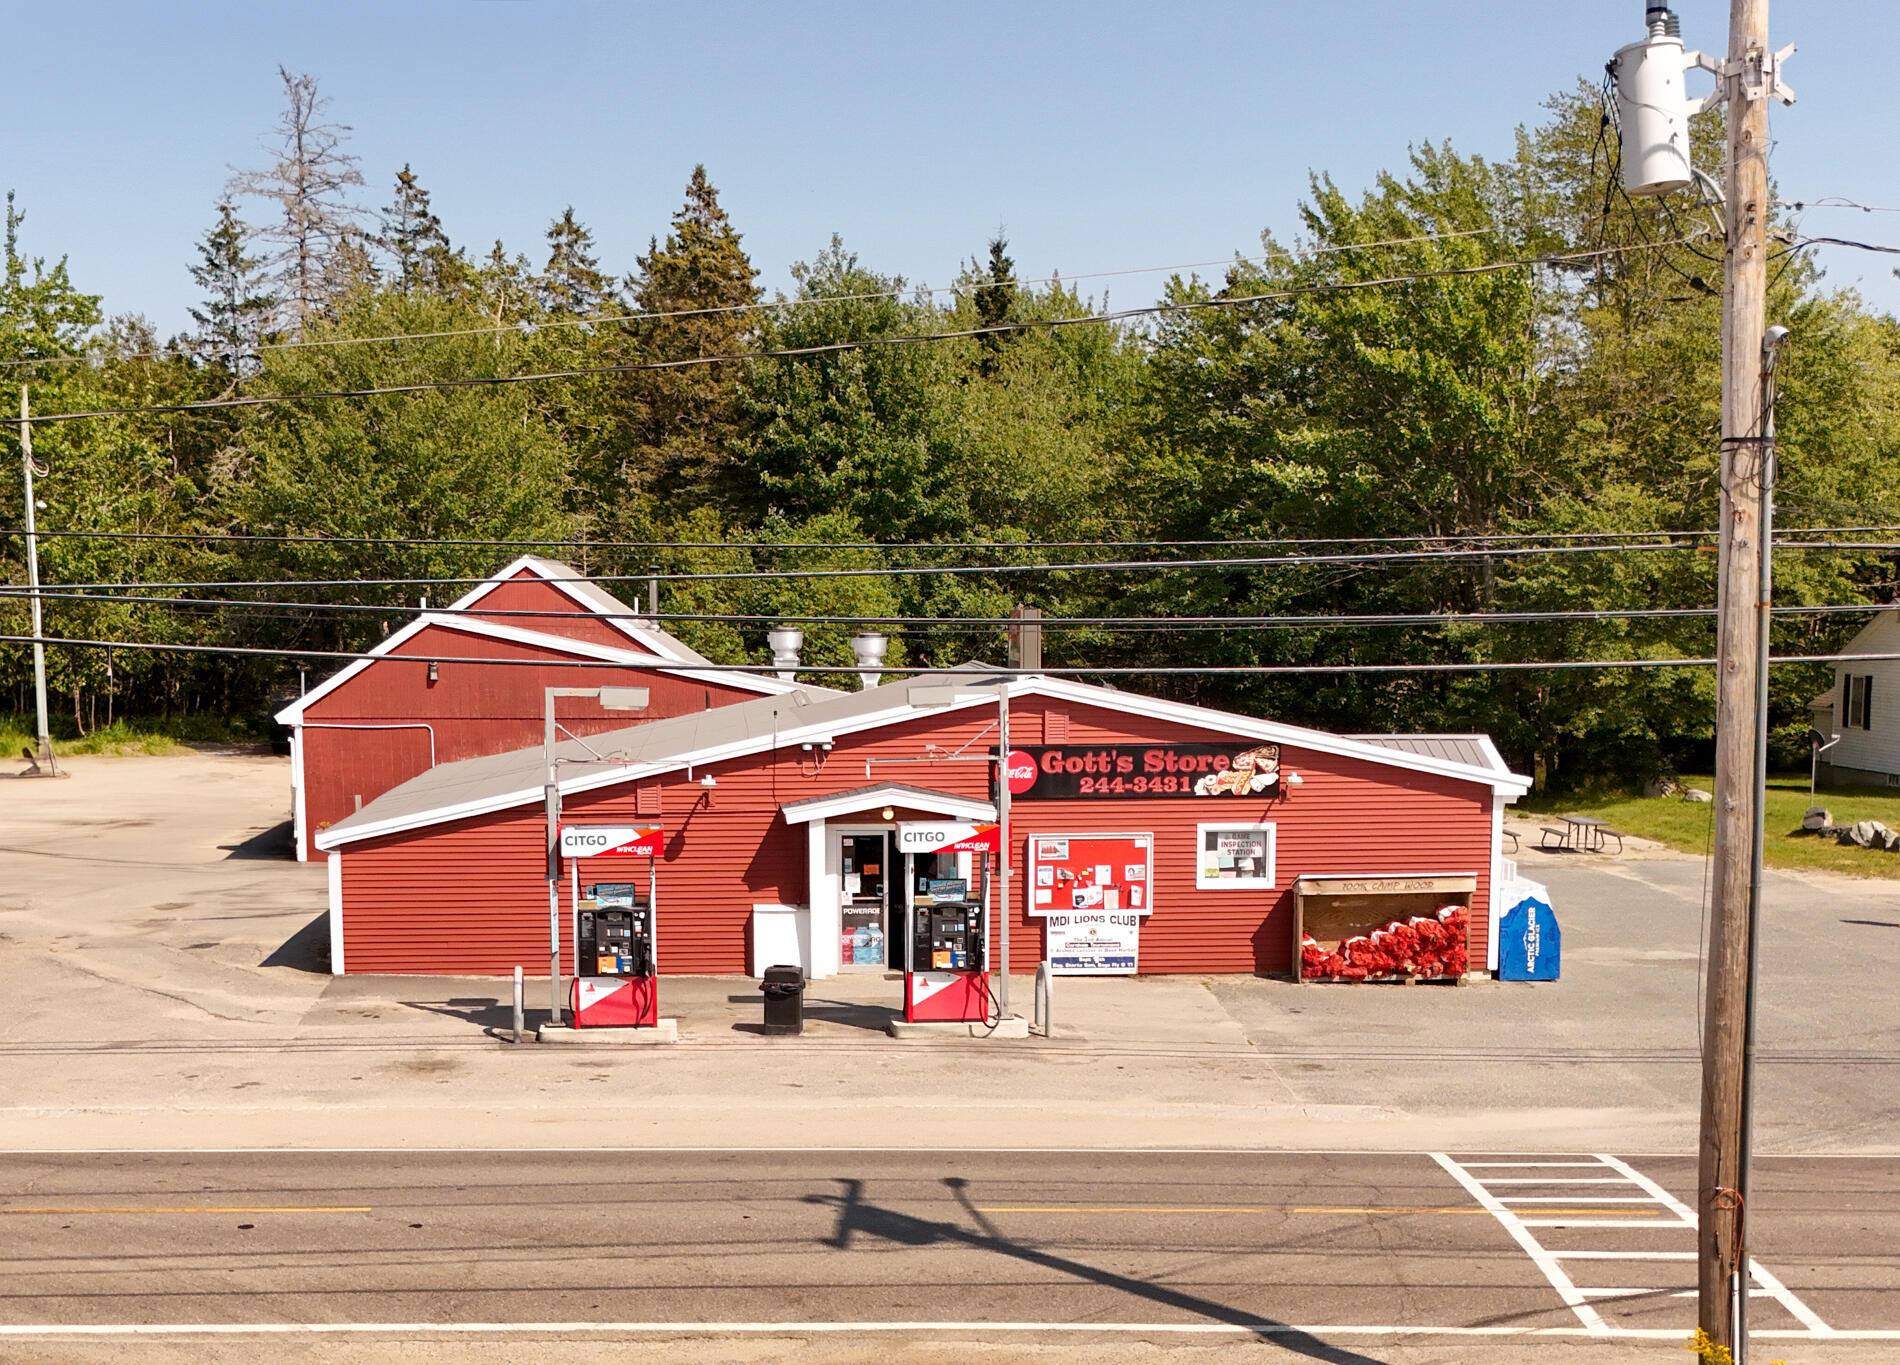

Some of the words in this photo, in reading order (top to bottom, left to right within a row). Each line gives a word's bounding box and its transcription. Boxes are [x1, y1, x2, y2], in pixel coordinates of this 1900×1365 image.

[1040, 750, 1134, 775] Gott's
[1143, 750, 1230, 774] Store
[1079, 776, 1192, 794] 244-3431
[564, 835, 607, 846] CITGO
[904, 831, 945, 842] CITGO
[1371, 881, 1400, 891] CAMP
[1404, 881, 1434, 890] WOOD
[1049, 916, 1070, 928] MDI
[1074, 915, 1106, 924] LIONS
[1110, 915, 1136, 927] CLUB
[1527, 907, 1536, 942] GLACIER
[1527, 942, 1536, 973] ARCTIC
